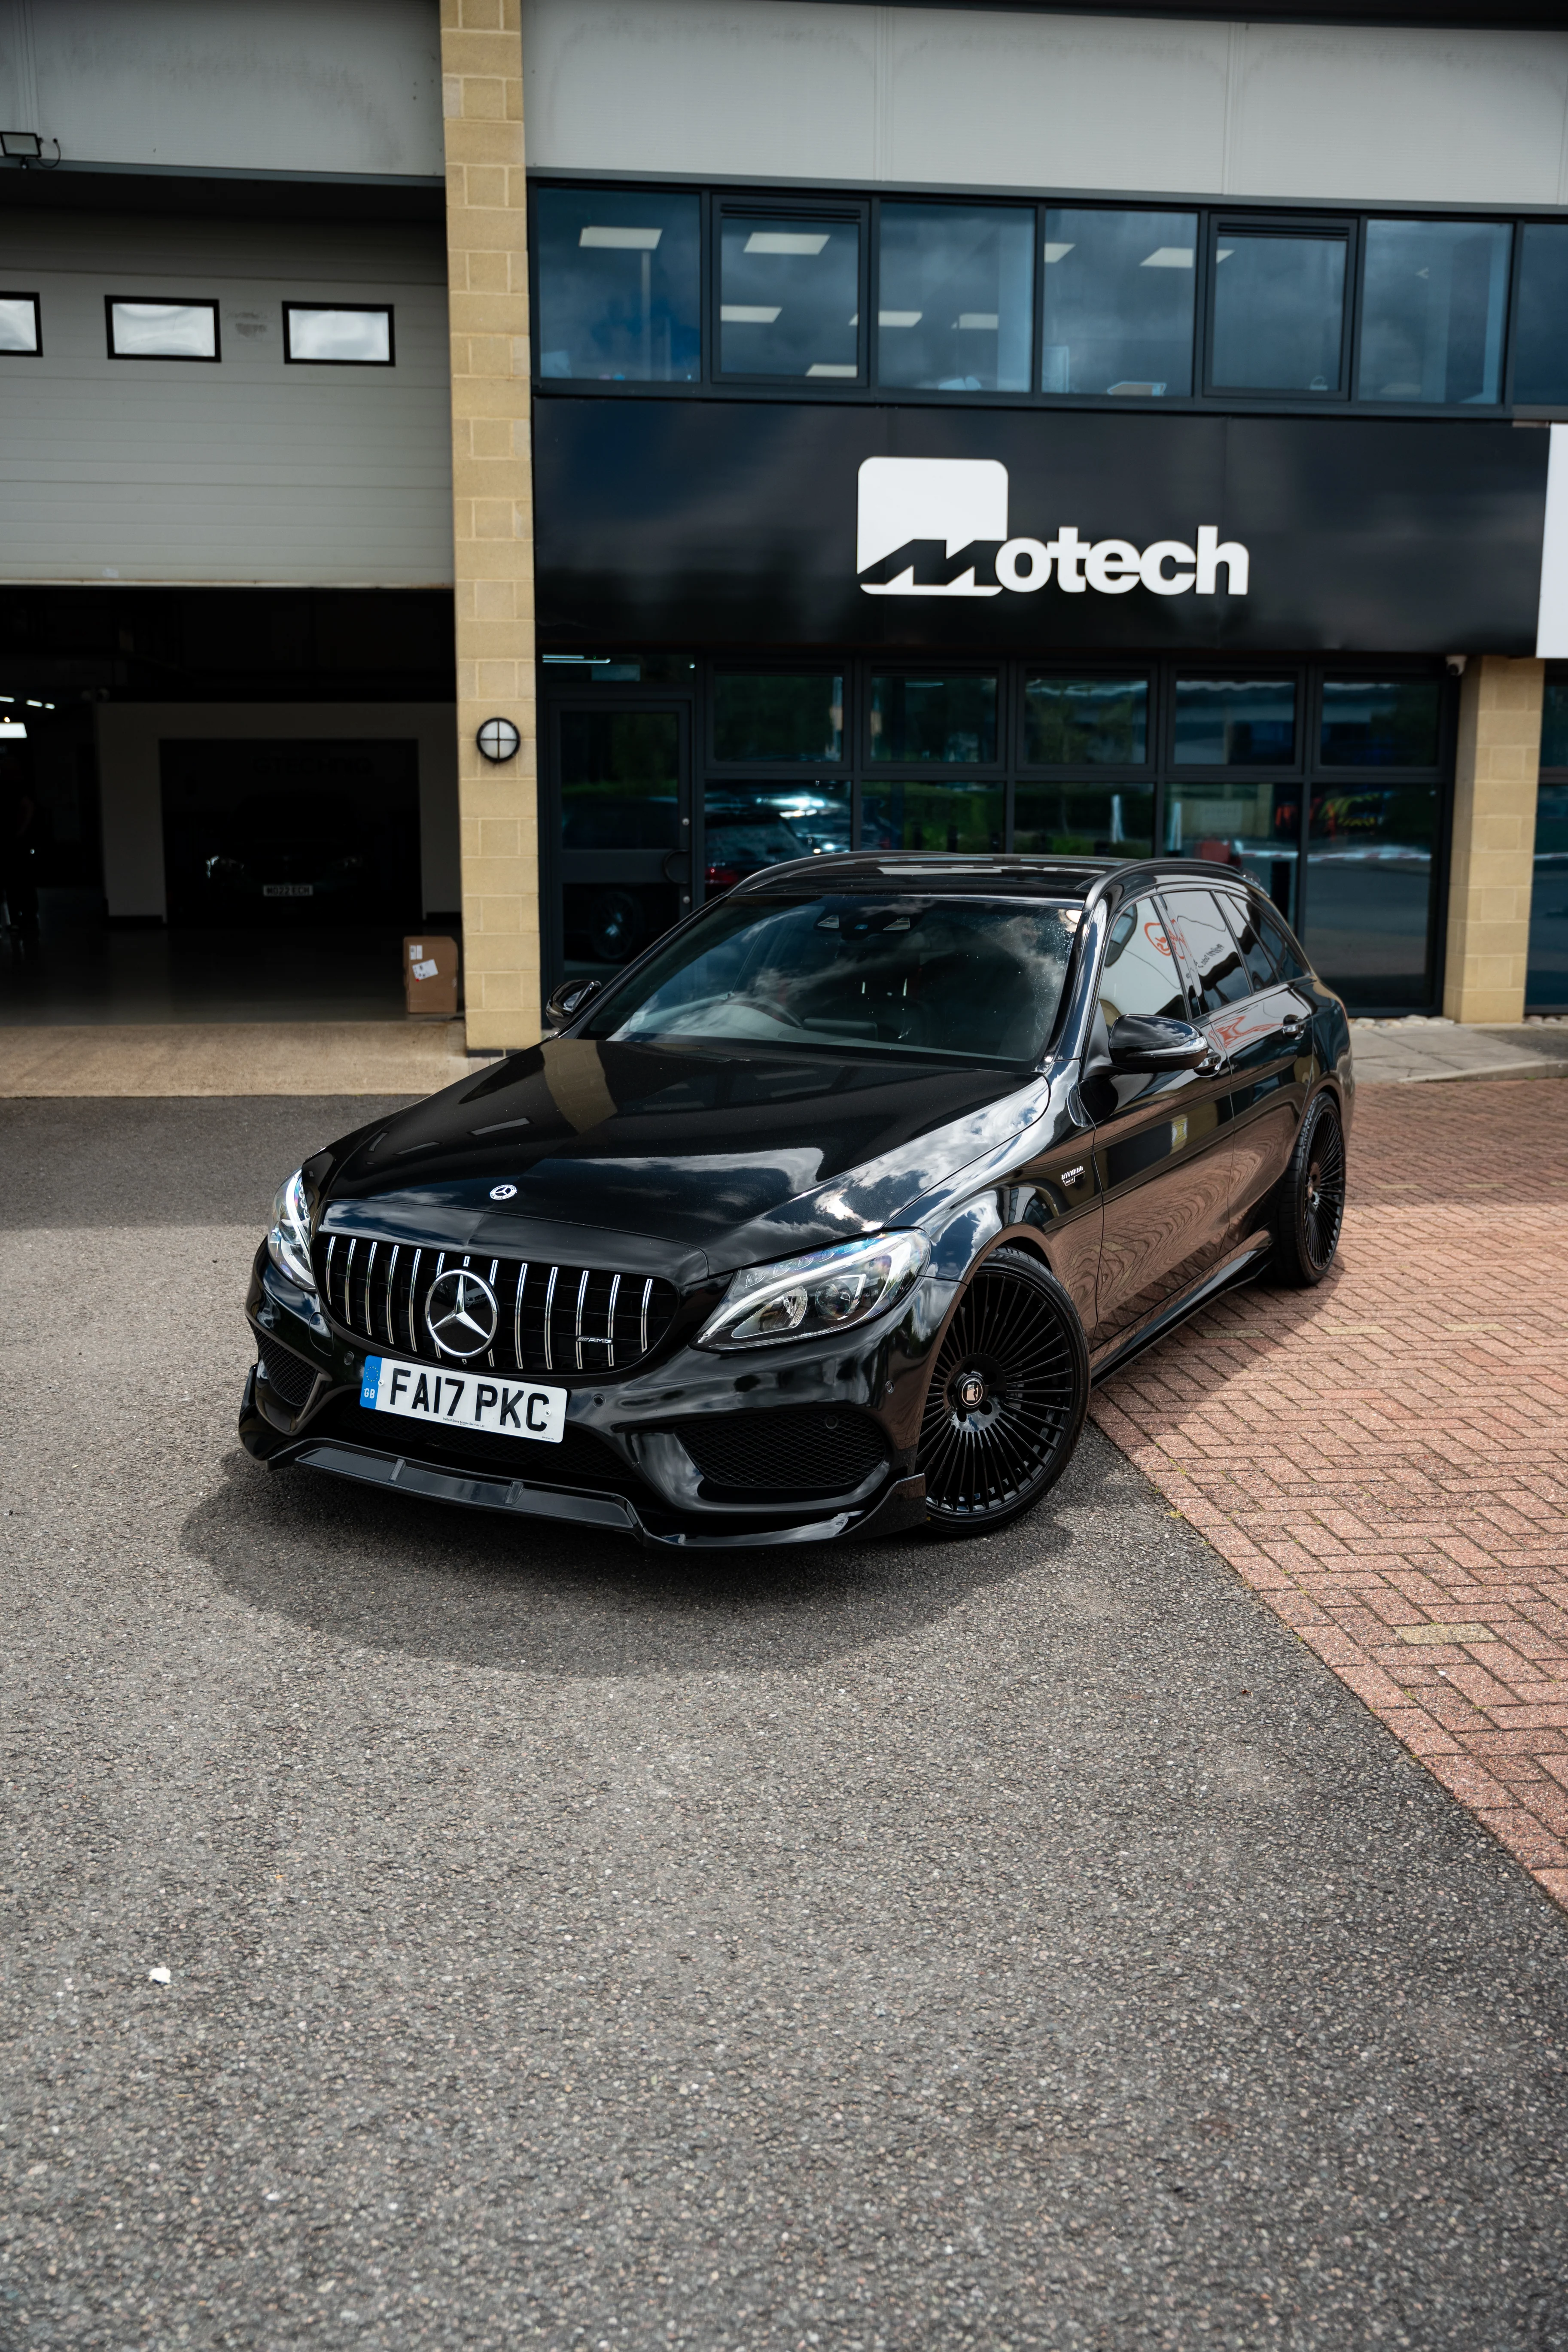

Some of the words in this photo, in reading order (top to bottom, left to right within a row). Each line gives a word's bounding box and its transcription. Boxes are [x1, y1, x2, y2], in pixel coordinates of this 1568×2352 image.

[364, 1387, 375, 1399] GB
[390, 1367, 465, 1416] FA17
[475, 1383, 550, 1432] PKC
